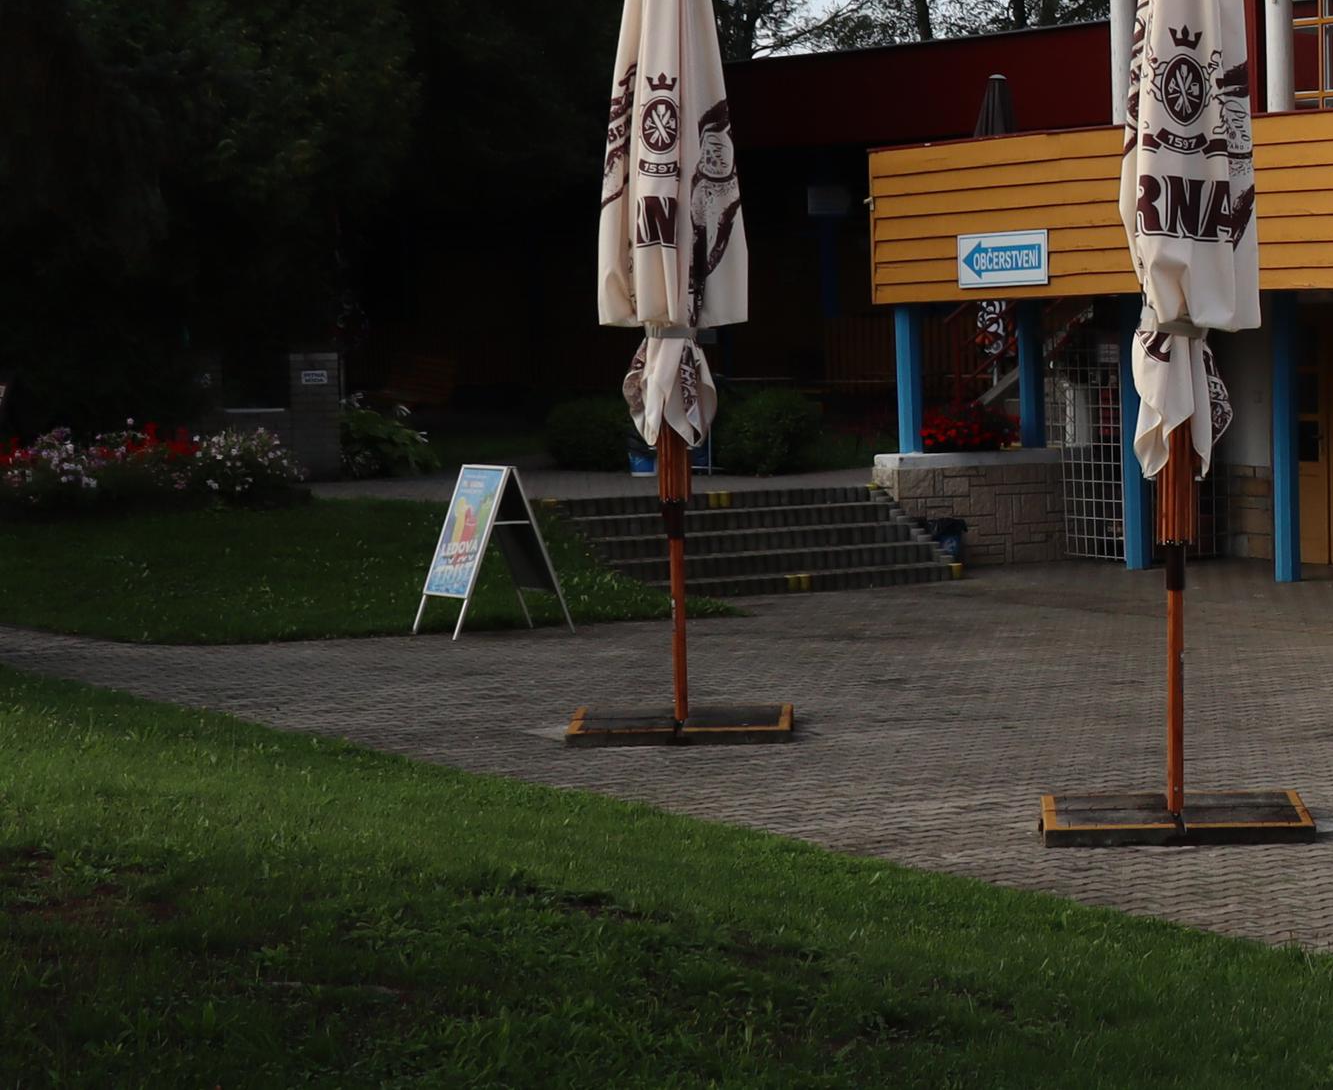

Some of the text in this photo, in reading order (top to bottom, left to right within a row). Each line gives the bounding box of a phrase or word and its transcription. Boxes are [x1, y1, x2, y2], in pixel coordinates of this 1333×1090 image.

[1167, 134, 1197, 149] 1597
[643, 163, 675, 173] 1597
[973, 246, 1039, 271] OBČERSTVENÍ
